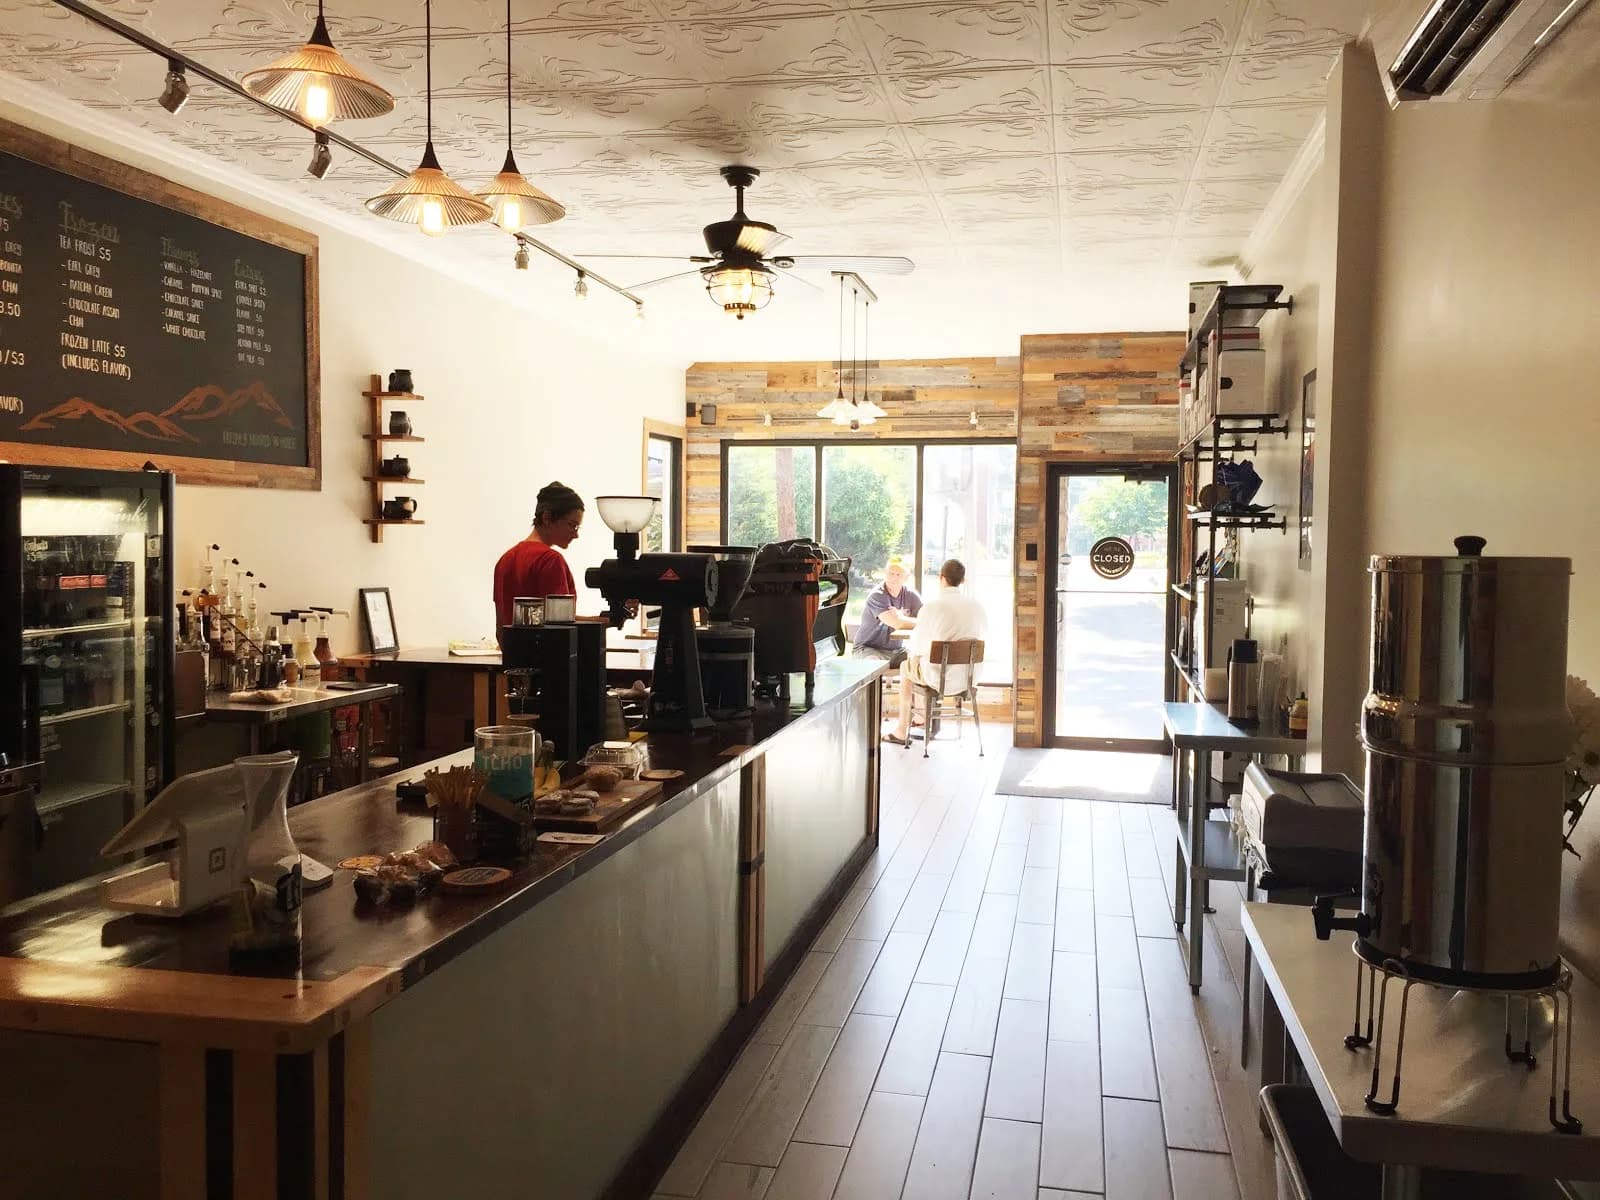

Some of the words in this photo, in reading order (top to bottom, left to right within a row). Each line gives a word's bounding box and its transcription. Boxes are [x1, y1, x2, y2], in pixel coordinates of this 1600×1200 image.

[59, 234, 71, 249] TEA
[75, 239, 95, 256] FROST
[67, 259, 82, 273] EARL
[84, 263, 100, 278] GREY
[94, 284, 113, 299] GREEN
[68, 297, 100, 315] CHOCOLATE
[102, 304, 120, 319] ASSAM
[68, 314, 84, 328] CHAI
[60, 332, 89, 350] FROZEN
[92, 338, 111, 356] LATTE
[61, 353, 99, 373] (INCLUDES
[102, 359, 131, 381] FLAVOR)
[1092, 554, 1131, 564] CLOSED
